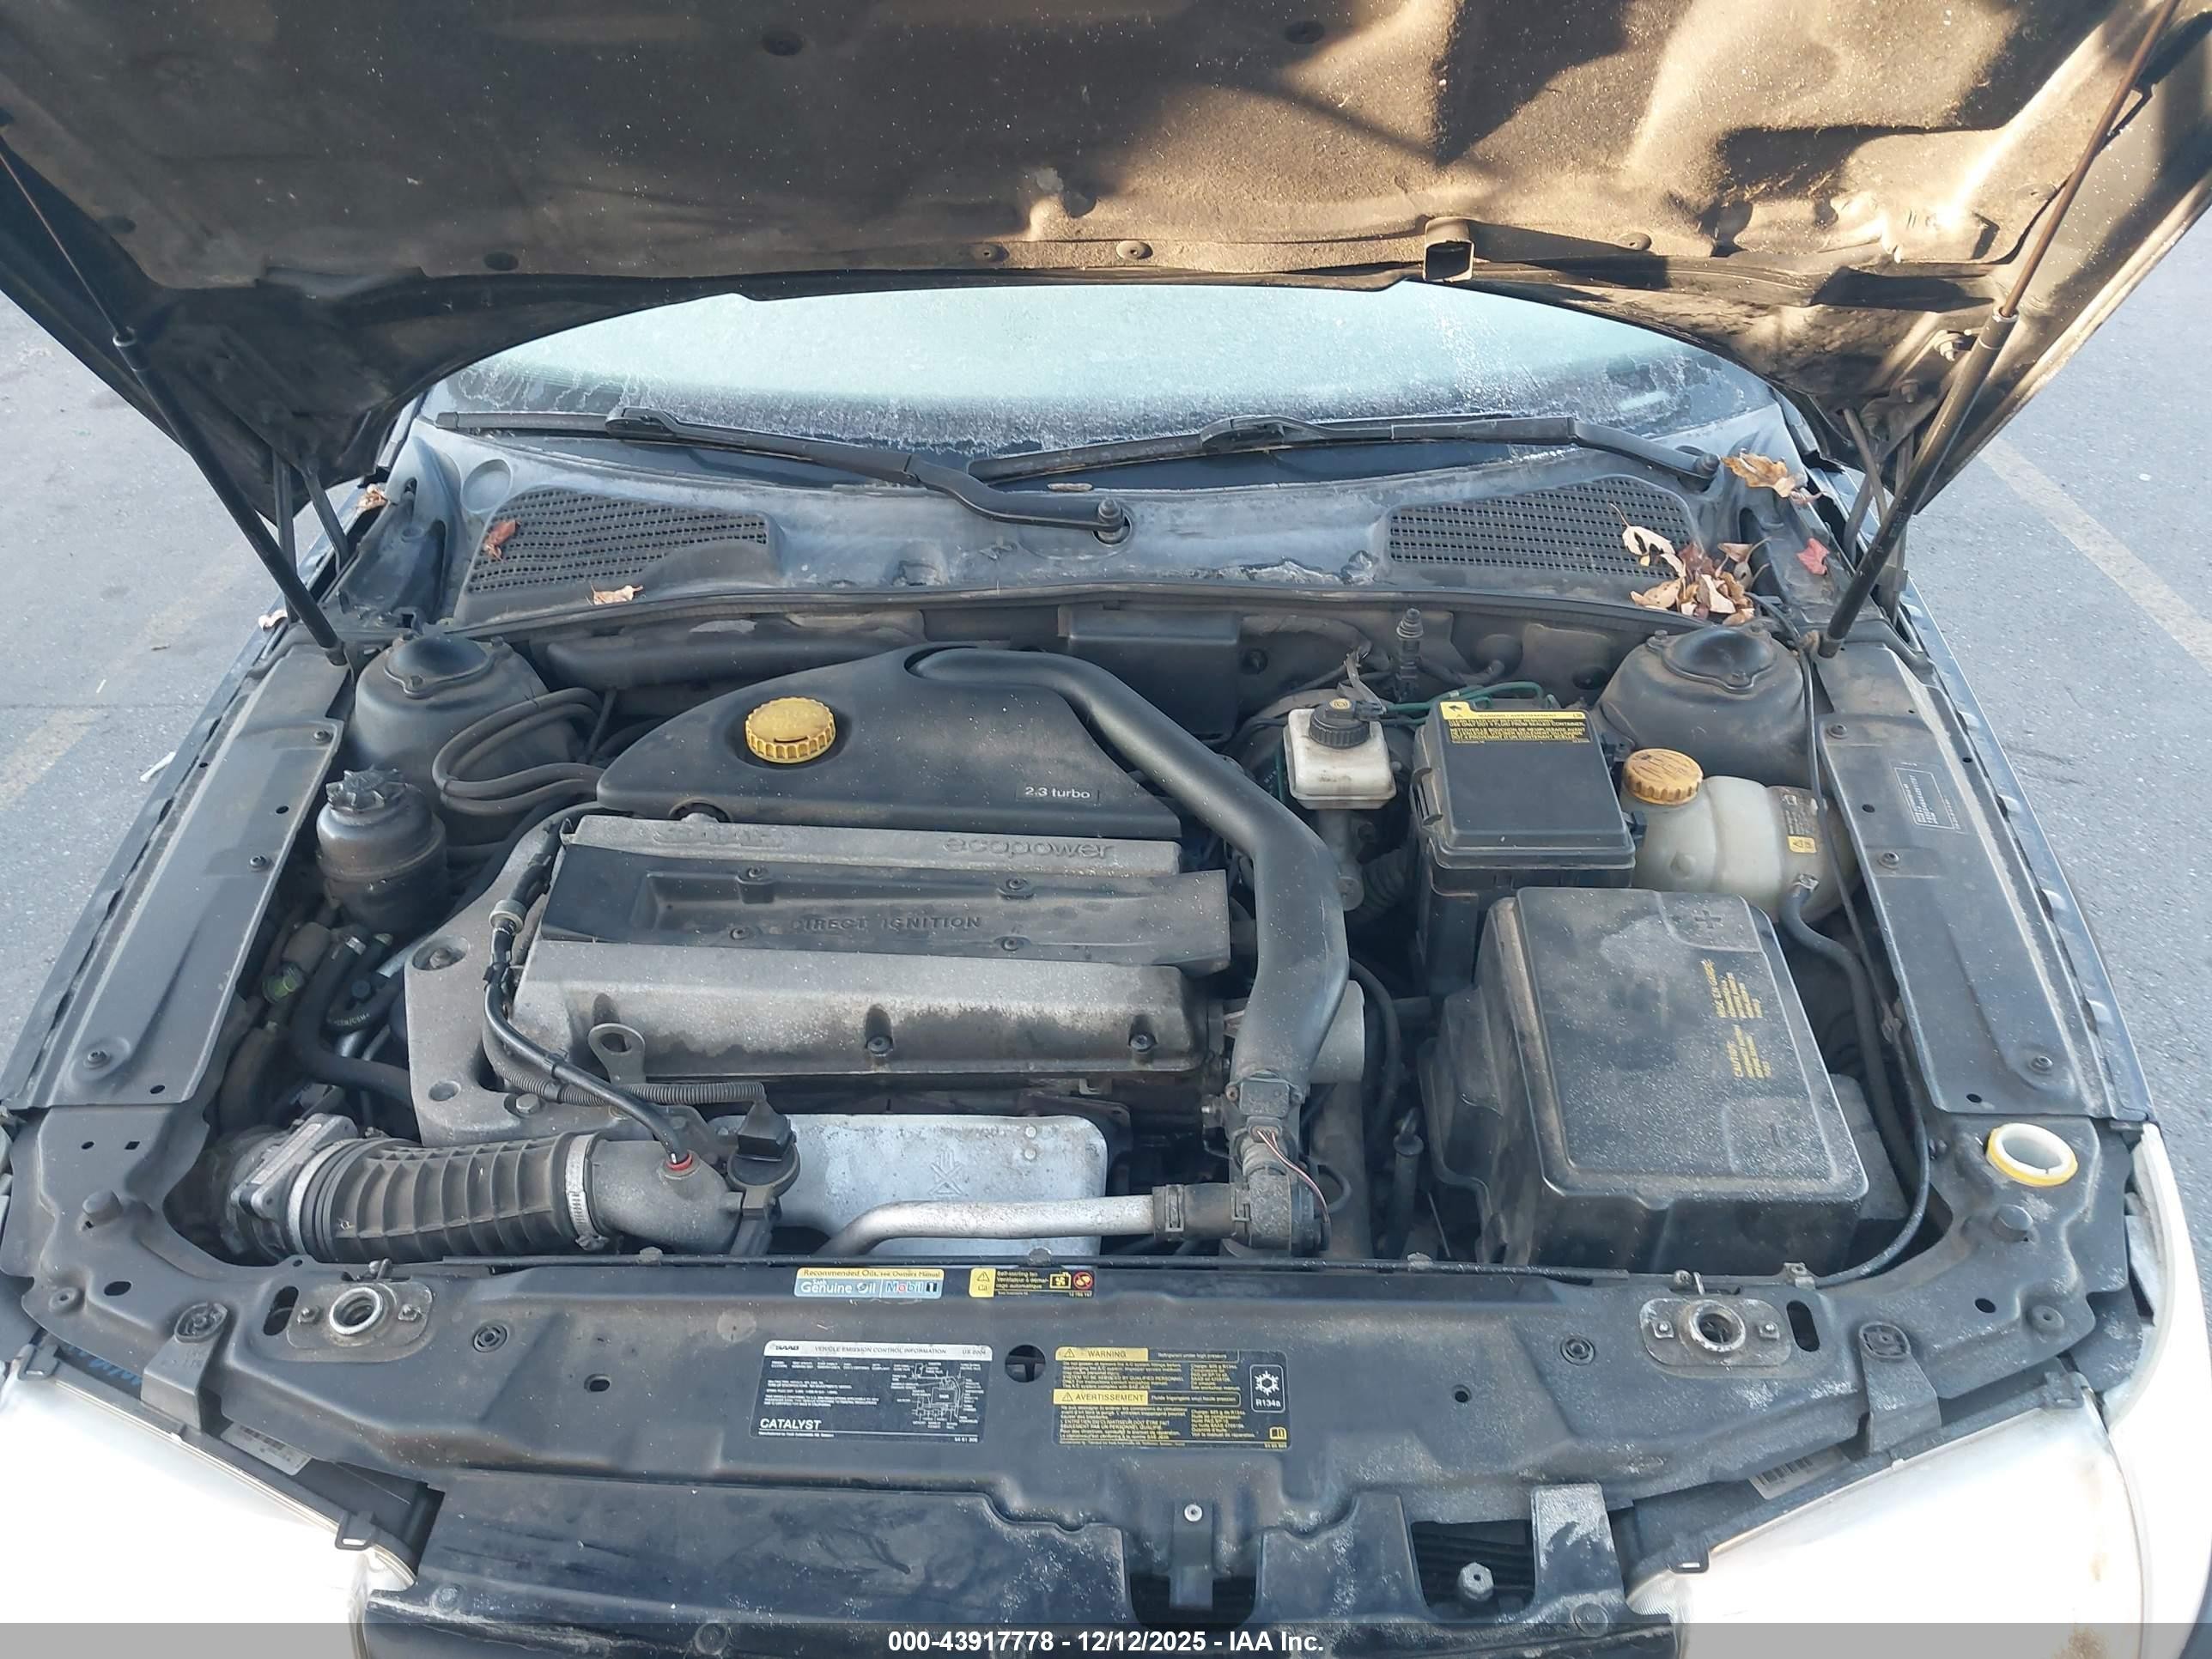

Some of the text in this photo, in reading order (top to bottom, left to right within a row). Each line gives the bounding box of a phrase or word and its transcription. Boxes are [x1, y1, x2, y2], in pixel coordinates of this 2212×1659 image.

[1024, 786, 1091, 799] 2.3 turbo
[943, 838, 1115, 859] ecopower
[791, 916, 981, 931] DIRECT IGNITION
[861, 1269, 878, 1278] Oils,
[800, 1280, 876, 1294] Genuine Oil
[885, 1280, 923, 1293] Mobil
[1086, 1350, 1127, 1358] WARNING
[1075, 1394, 1145, 1402] AVERTISSEMENT
[1255, 1398, 1281, 1407] R134a
[759, 1418, 822, 1430] CATALYST
